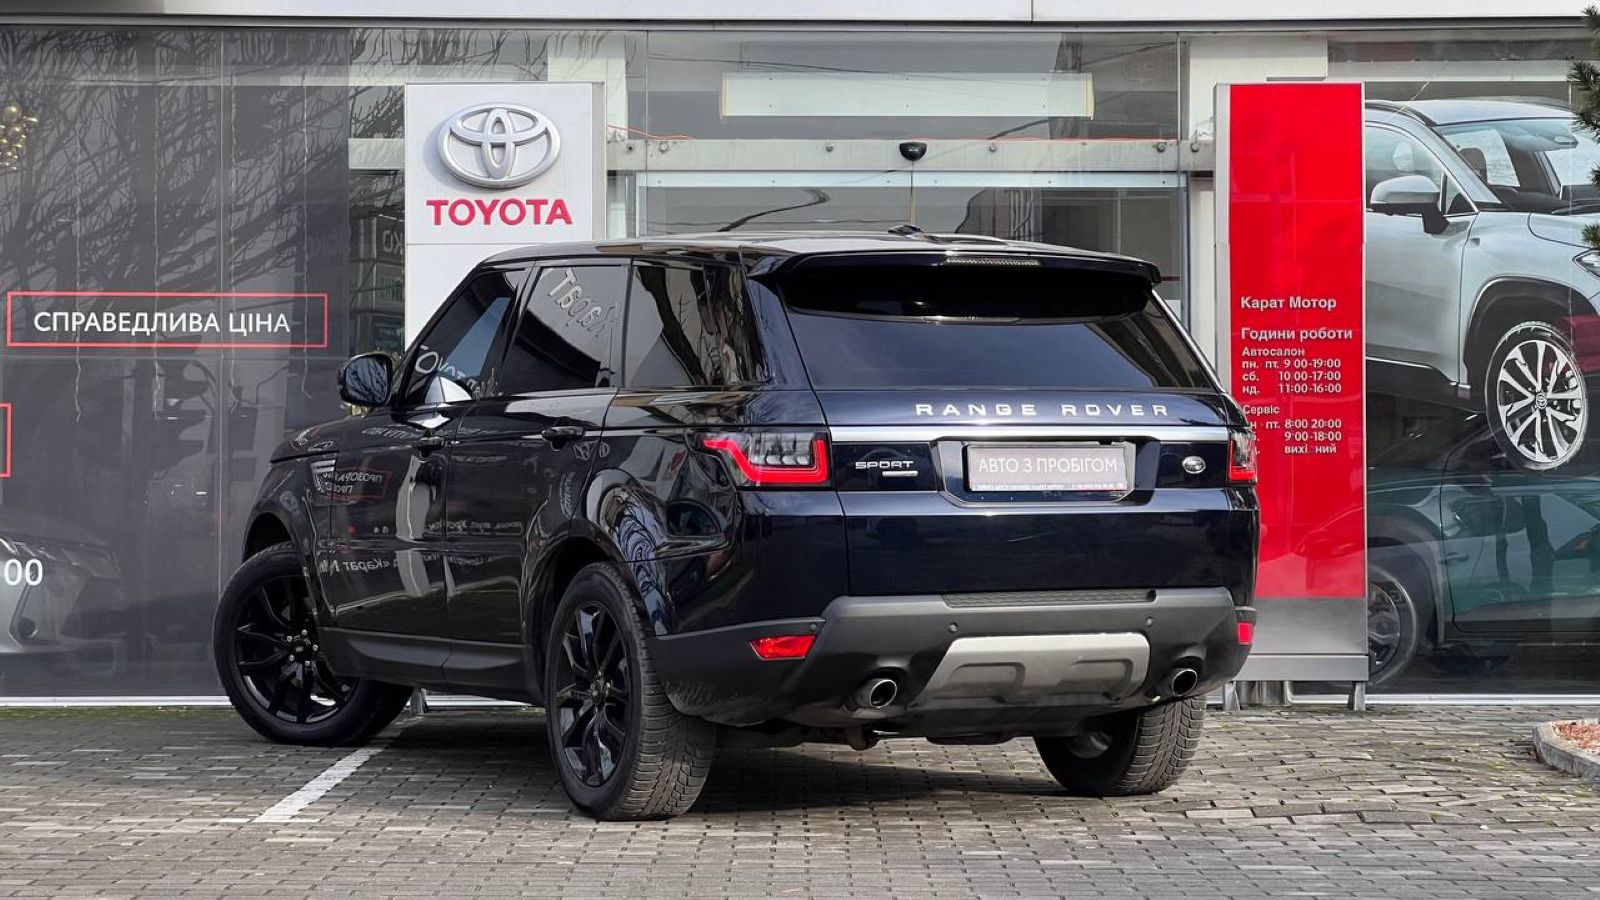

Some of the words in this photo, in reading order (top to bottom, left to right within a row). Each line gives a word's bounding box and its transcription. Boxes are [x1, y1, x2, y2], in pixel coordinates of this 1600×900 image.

[426, 199, 572, 226] TOYOTA
[1241, 297, 1285, 311] Карат
[1289, 296, 1337, 311] Мотор
[33, 312, 220, 336] СПРАВЕДЛИВА
[229, 312, 291, 336] ЦІНА
[1241, 328, 1296, 341] Години
[1299, 327, 1353, 342] роботи
[1242, 346, 1305, 357] Автосалон
[1241, 360, 1259, 369] пн.
[1242, 371, 1259, 381] сб.
[1242, 385, 1260, 395] нд.
[1279, 383, 1342, 393] 11:00-16:00
[915, 404, 1037, 416] RANGE
[1061, 404, 1168, 417] ROVER
[1242, 404, 1280, 416] Сервіс
[855, 460, 915, 470] SPORT
[978, 457, 1019, 474] АВТО
[1036, 456, 1118, 474] ПРОБІГОМ
